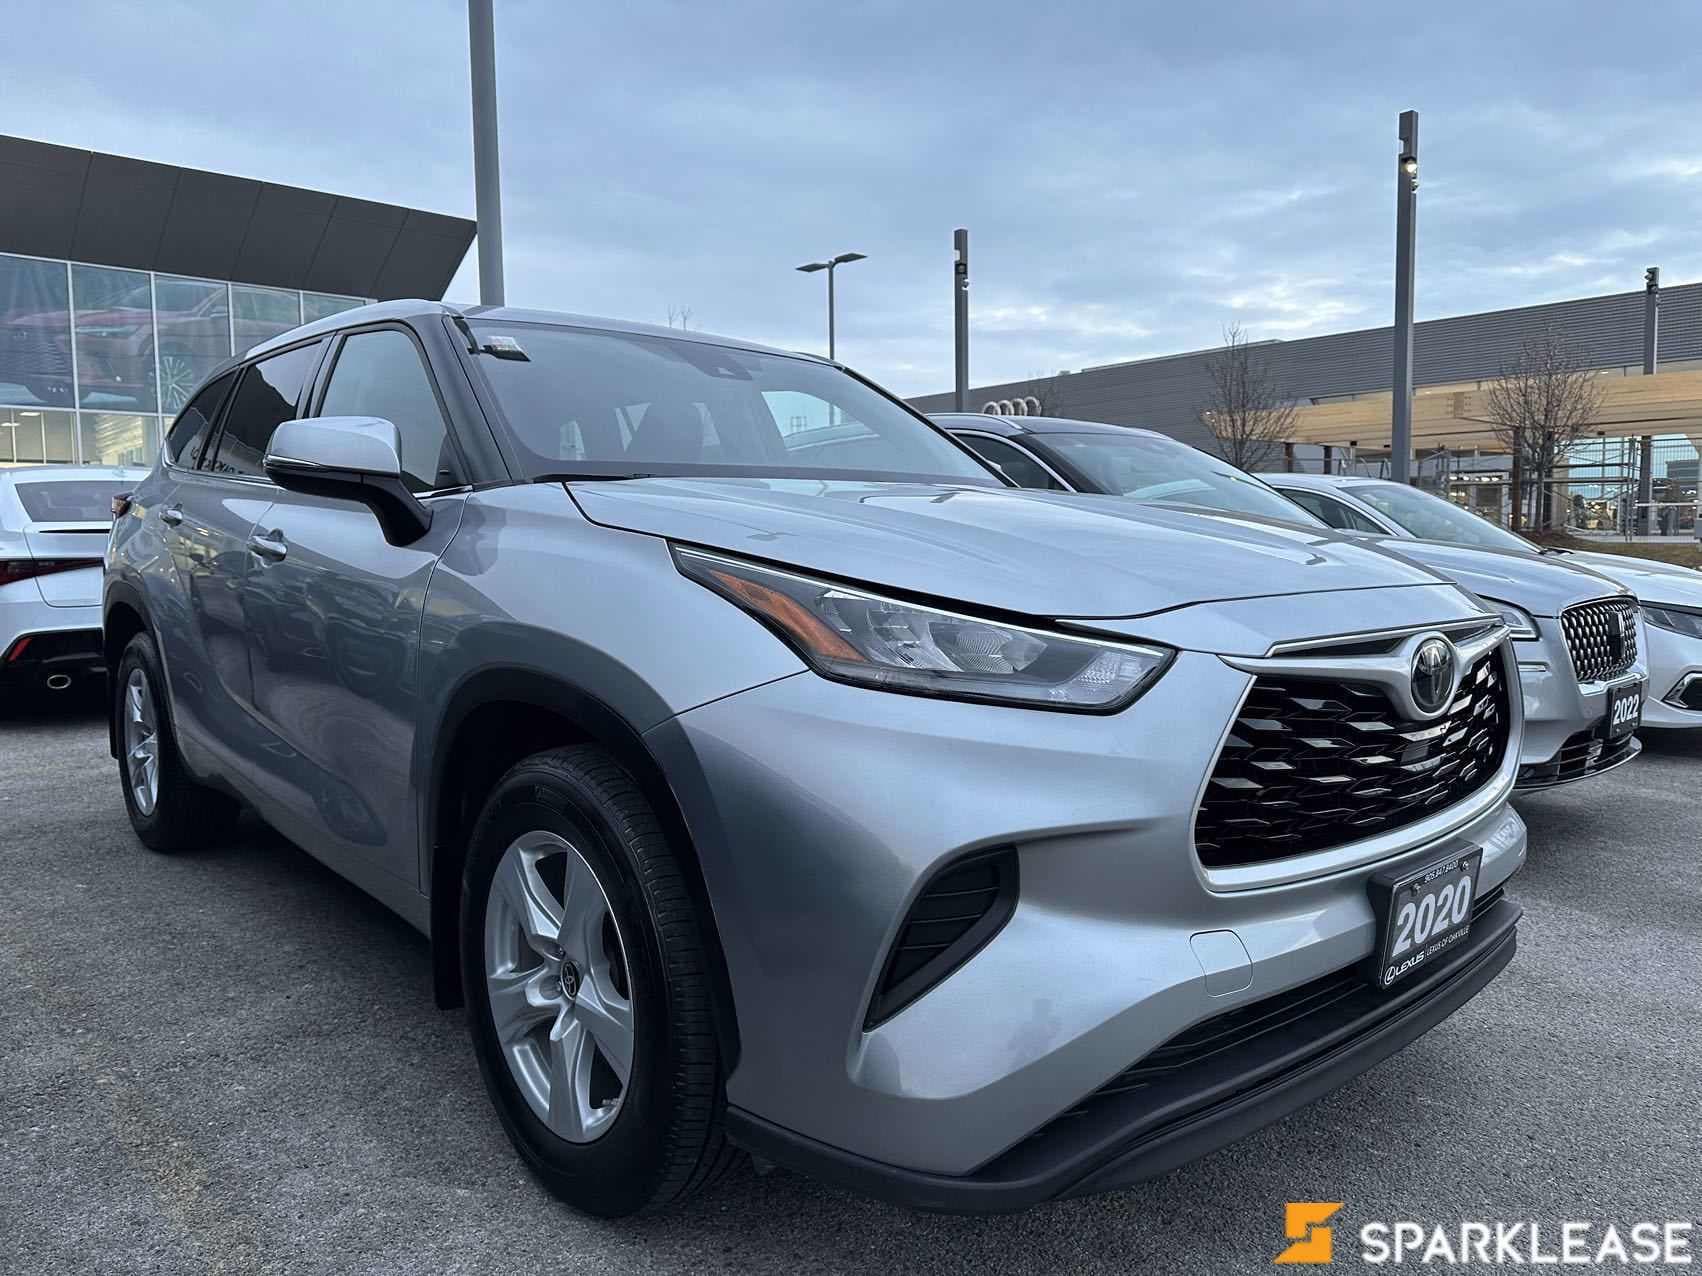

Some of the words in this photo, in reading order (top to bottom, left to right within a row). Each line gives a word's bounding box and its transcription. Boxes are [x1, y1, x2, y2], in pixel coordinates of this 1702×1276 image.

[1613, 694, 1639, 725] 2022
[1392, 875, 1472, 957] 2020
[1395, 950, 1425, 976] LEXUS
[1426, 940, 1441, 956] LEXUS
